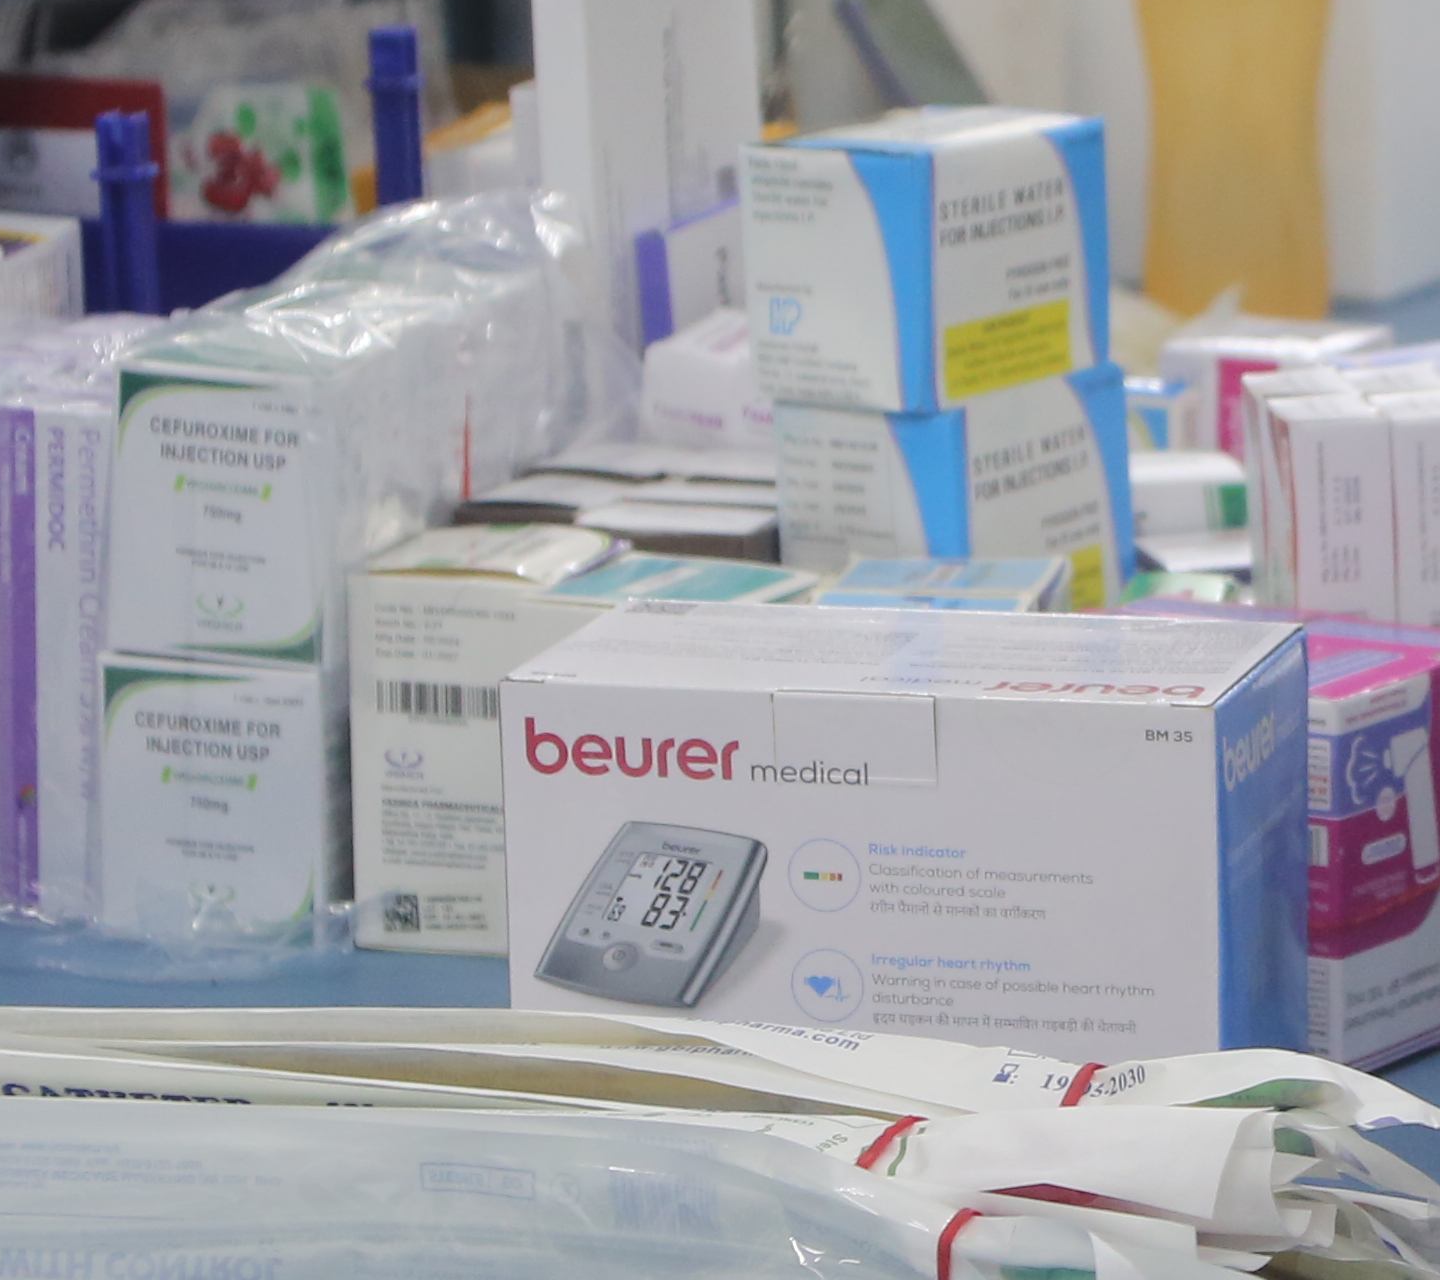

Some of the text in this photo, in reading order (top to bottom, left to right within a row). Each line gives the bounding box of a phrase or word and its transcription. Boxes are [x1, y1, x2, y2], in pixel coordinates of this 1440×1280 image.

[938, 177, 1063, 223] STERILE WATER
[938, 221, 966, 248] FOR
[970, 210, 1043, 241] INJECTIONS
[150, 415, 300, 447] CEFUROXIME FOR
[160, 443, 287, 471] INJECTION USP
[973, 426, 1086, 475] STERILE WATER
[48, 426, 66, 551] PERMIDOC
[974, 479, 1001, 502] FOR
[1003, 462, 1070, 495] INJECTIONS
[78, 428, 101, 583] Permethrin
[982, 680, 1206, 699] beurer
[134, 711, 282, 739] CEFUROXIME FOR
[1144, 729, 1194, 742] BM 35
[145, 735, 270, 762] INJECTION USP
[523, 716, 870, 787] beurer medical
[1221, 710, 1276, 792] beurer
[661, 840, 703, 855] beurer
[868, 843, 898, 857] Risk
[652, 859, 709, 897] 128
[868, 863, 1094, 886] Classification of measurements
[869, 882, 1006, 900] with coloured scale
[640, 892, 691, 931] 83
[871, 953, 1031, 973] Irregular heart rhythm
[871, 973, 1155, 1000] Warning in case of possible heart rhythm
[871, 991, 954, 1008] disturbance
[1039, 1065, 1147, 1099] 195-2030
[814, 1133, 849, 1153] Ster
